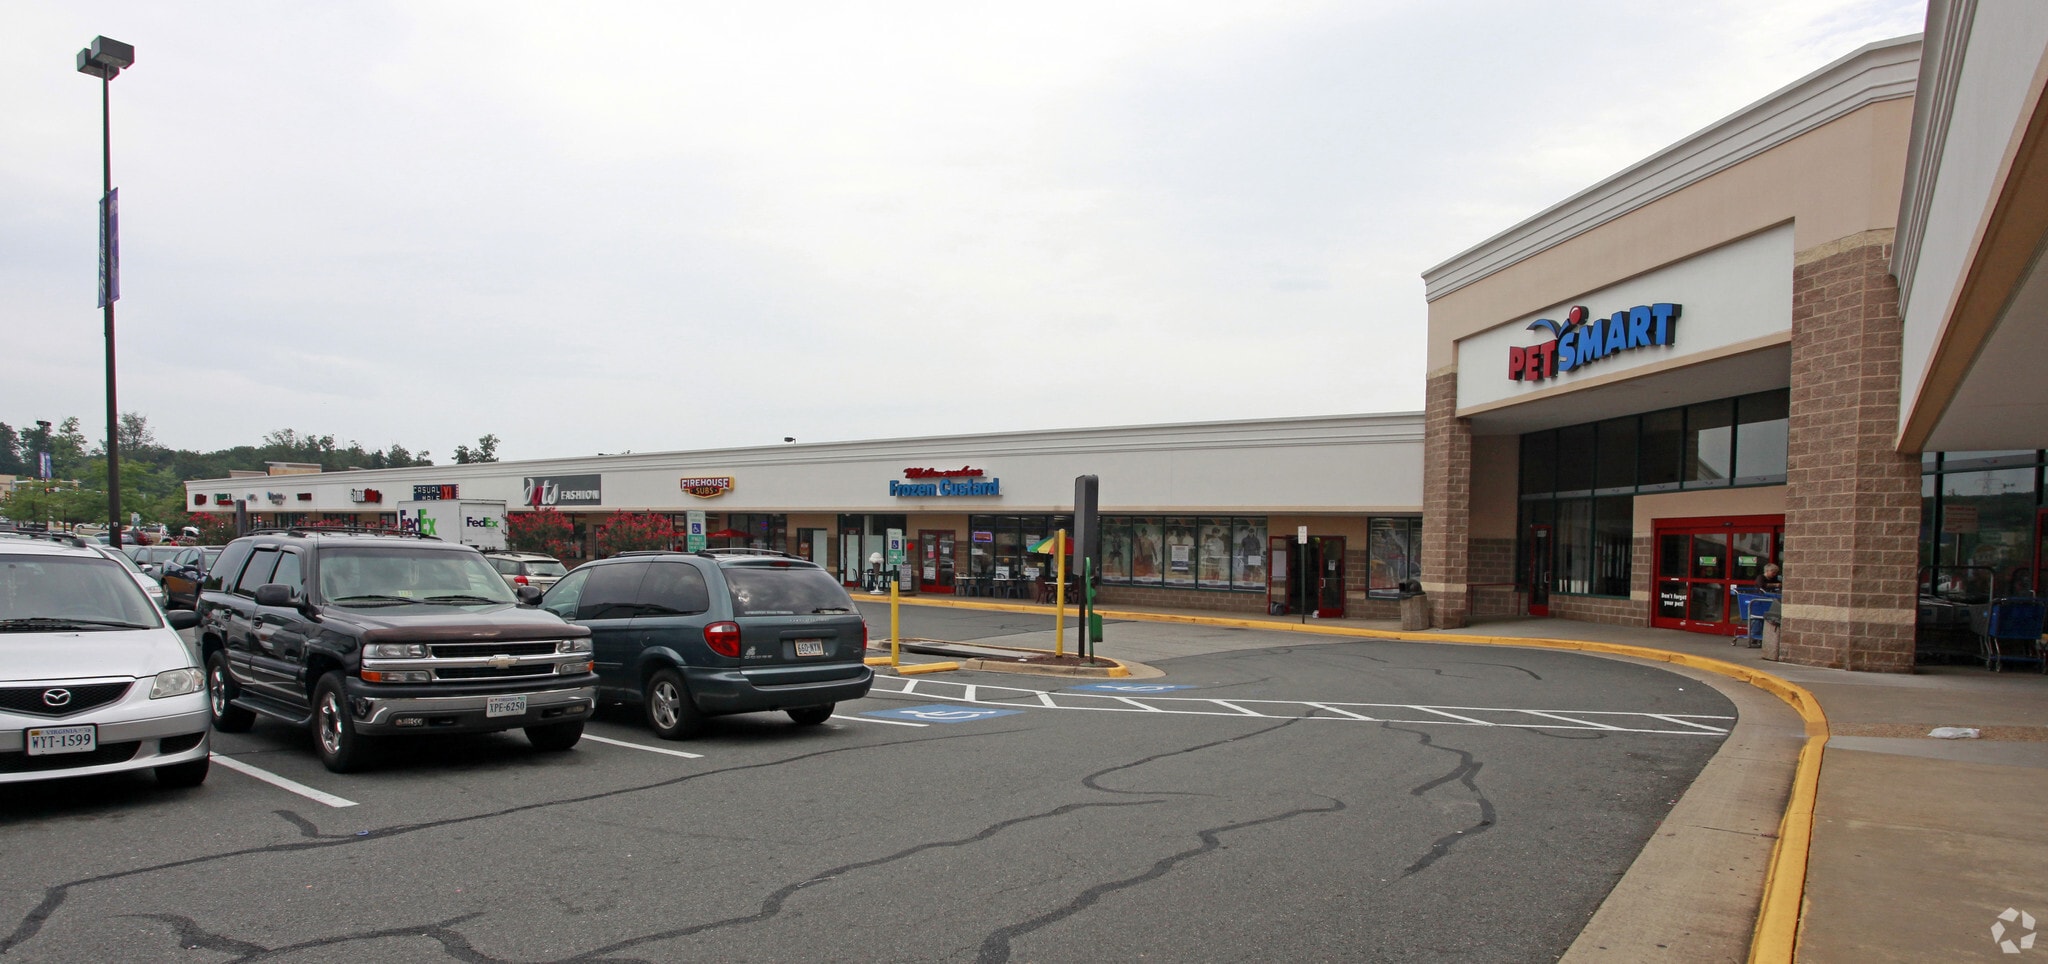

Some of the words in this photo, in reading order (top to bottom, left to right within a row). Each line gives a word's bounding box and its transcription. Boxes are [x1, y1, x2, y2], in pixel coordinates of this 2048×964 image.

[414, 486, 440, 494] CASUAL
[681, 478, 729, 490] FIREHOUSE
[890, 480, 936, 497] Frozen
[939, 478, 1000, 496] Custard
[561, 490, 600, 501] FASHION
[695, 487, 714, 495] SUBS
[400, 508, 437, 535] FedEx
[467, 517, 498, 528] FedEx
[489, 701, 525, 713] XPE-6250
[32, 733, 91, 748] WYT-1599
